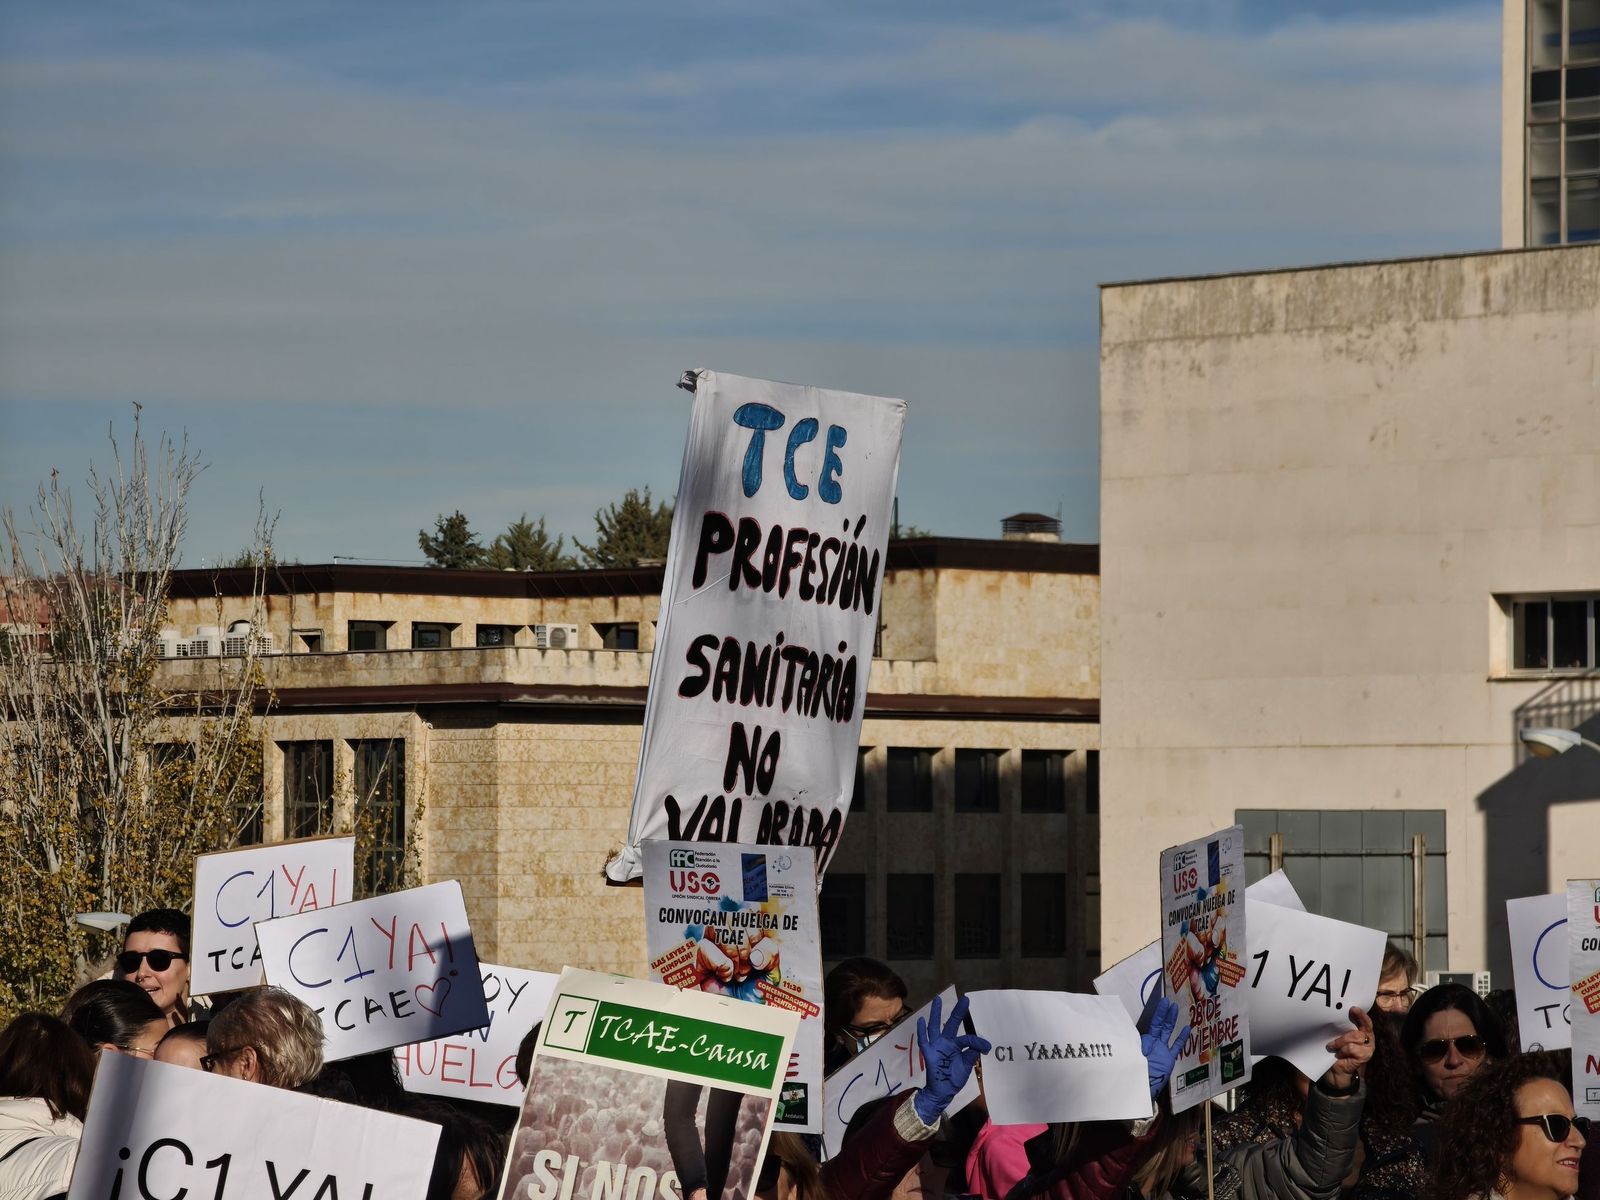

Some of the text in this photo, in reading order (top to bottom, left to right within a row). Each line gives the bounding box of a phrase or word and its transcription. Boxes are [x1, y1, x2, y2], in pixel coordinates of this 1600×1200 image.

[733, 402, 847, 504] TCE
[722, 721, 780, 796] NO
[670, 870, 720, 894] USO
[1173, 867, 1198, 894] USO
[215, 870, 279, 928] C1
[1227, 889, 1236, 906] DE
[659, 907, 799, 932] CONVOCAN HUELGA DE
[715, 928, 744, 945] TCAE
[288, 914, 458, 988] C1 YA!
[665, 945, 686, 964] LEYES
[685, 941, 696, 952] SE
[782, 981, 802, 993] 11:30
[1287, 954, 1351, 1010] YA!
[313, 989, 416, 1031] CAE
[774, 996, 797, 1011] CENTRO
[808, 1004, 818, 1014] EN
[1189, 994, 1222, 1028] 28 DE
[564, 1010, 770, 1072] T TCAE-Causa
[994, 1041, 1113, 1062] C1 YAAAA!!!!
